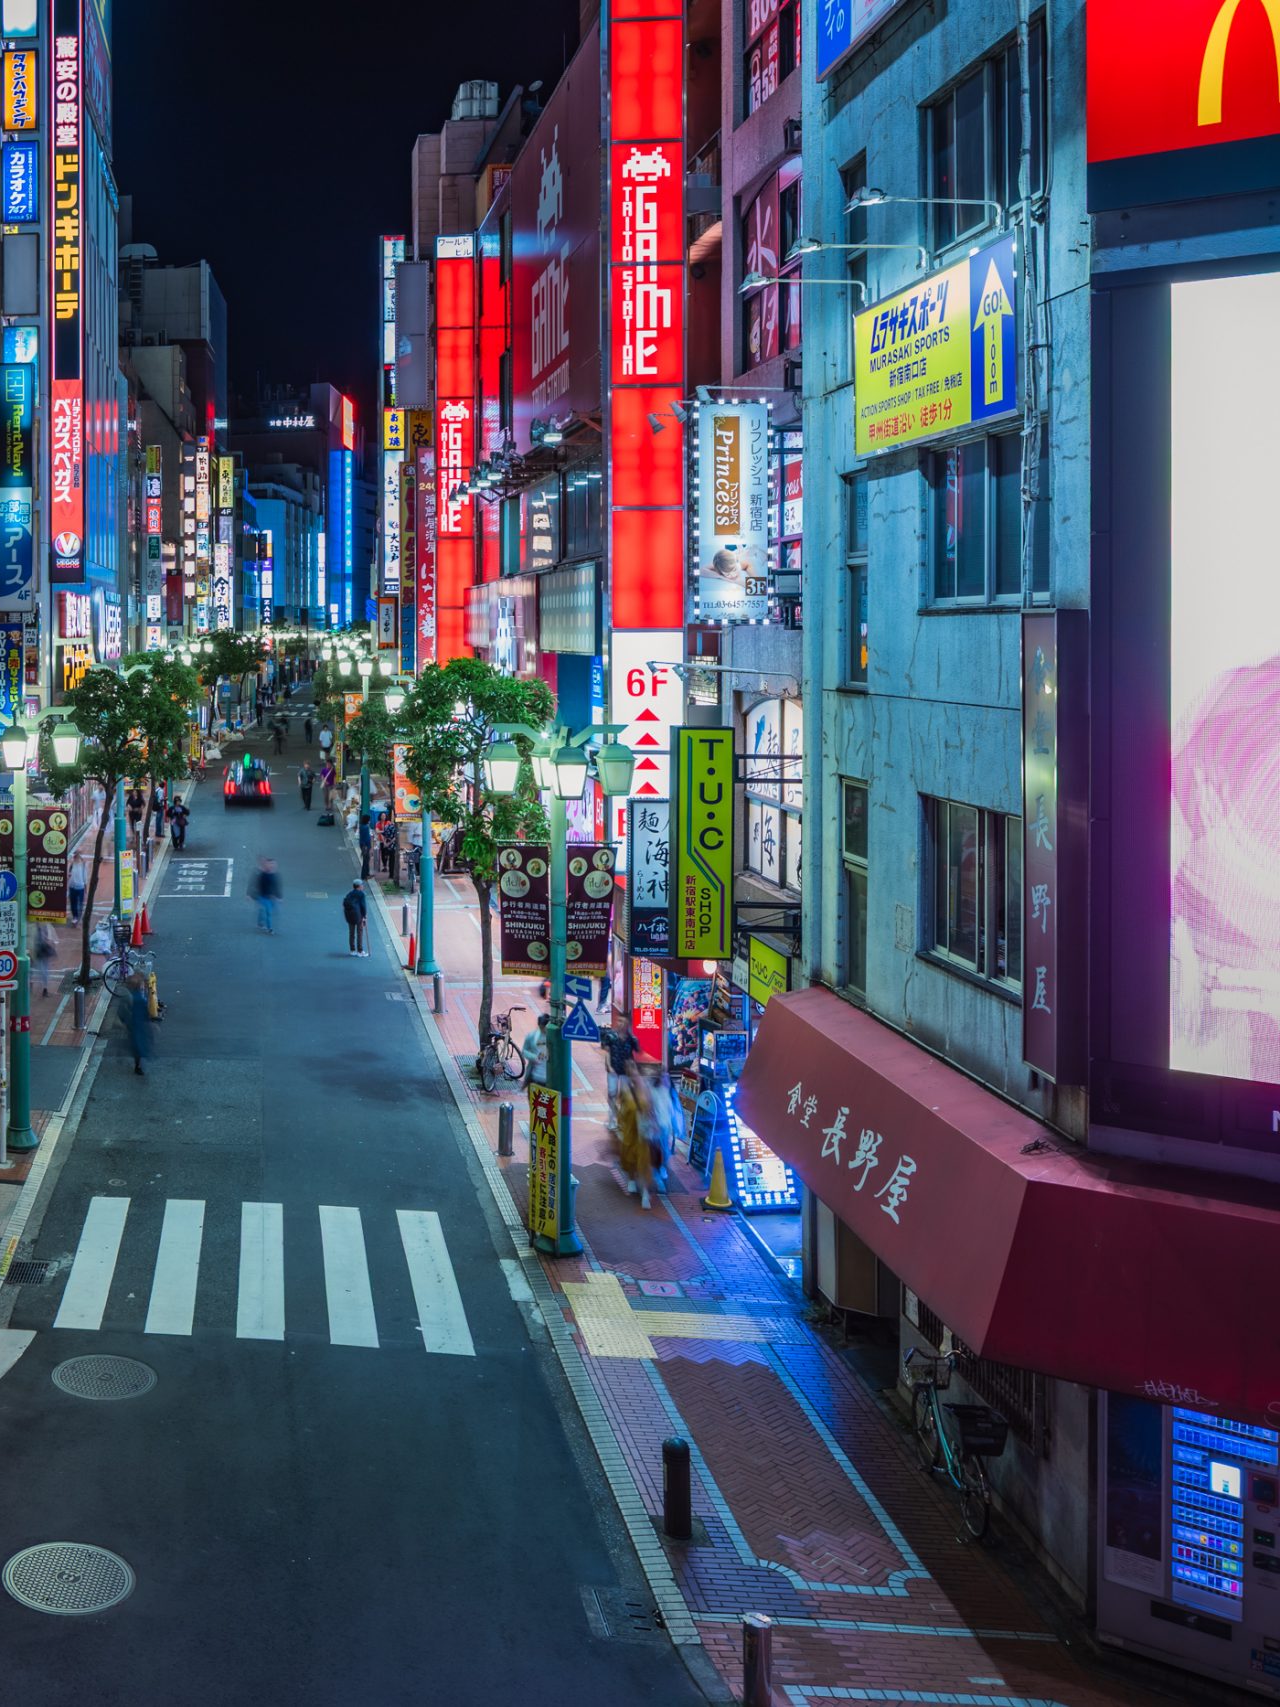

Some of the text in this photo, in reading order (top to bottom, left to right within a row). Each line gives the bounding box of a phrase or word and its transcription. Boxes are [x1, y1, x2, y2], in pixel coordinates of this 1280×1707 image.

[12, 52, 32, 128] タウンハウジング
[55, 36, 78, 147] 驚安の殿堂
[9, 151, 26, 206] カラオケ
[8, 205, 27, 215] 747
[622, 186, 634, 376] TAITO STATION
[635, 185, 672, 376] GAME
[983, 288, 1003, 316] GO!
[870, 280, 949, 356] ムラサキスポーツ
[869, 326, 950, 374] MURASAKI SPORTS
[889, 357, 927, 389] 新宿南口店
[944, 372, 963, 392] 免税店
[868, 398, 953, 444] 甲州街道沿い 徒歩1分
[53, 398, 72, 503] ベガスベガス
[749, 418, 763, 532] リフレッシュ 新宿店
[716, 429, 735, 527] Princess
[728, 482, 740, 525] プリンセス
[4, 527, 25, 585] アース
[17, 590, 32, 601] 4F
[745, 578, 767, 596] 3F
[626, 667, 669, 697] 6F
[504, 921, 545, 930] SHINJUKU
[567, 921, 607, 930] SHINJUKU
[684, 875, 697, 951] 新宿駅東南口店
[700, 887, 712, 938] SHOP
[787, 1081, 818, 1128] 食堂
[822, 1106, 919, 1226] 長野屋
